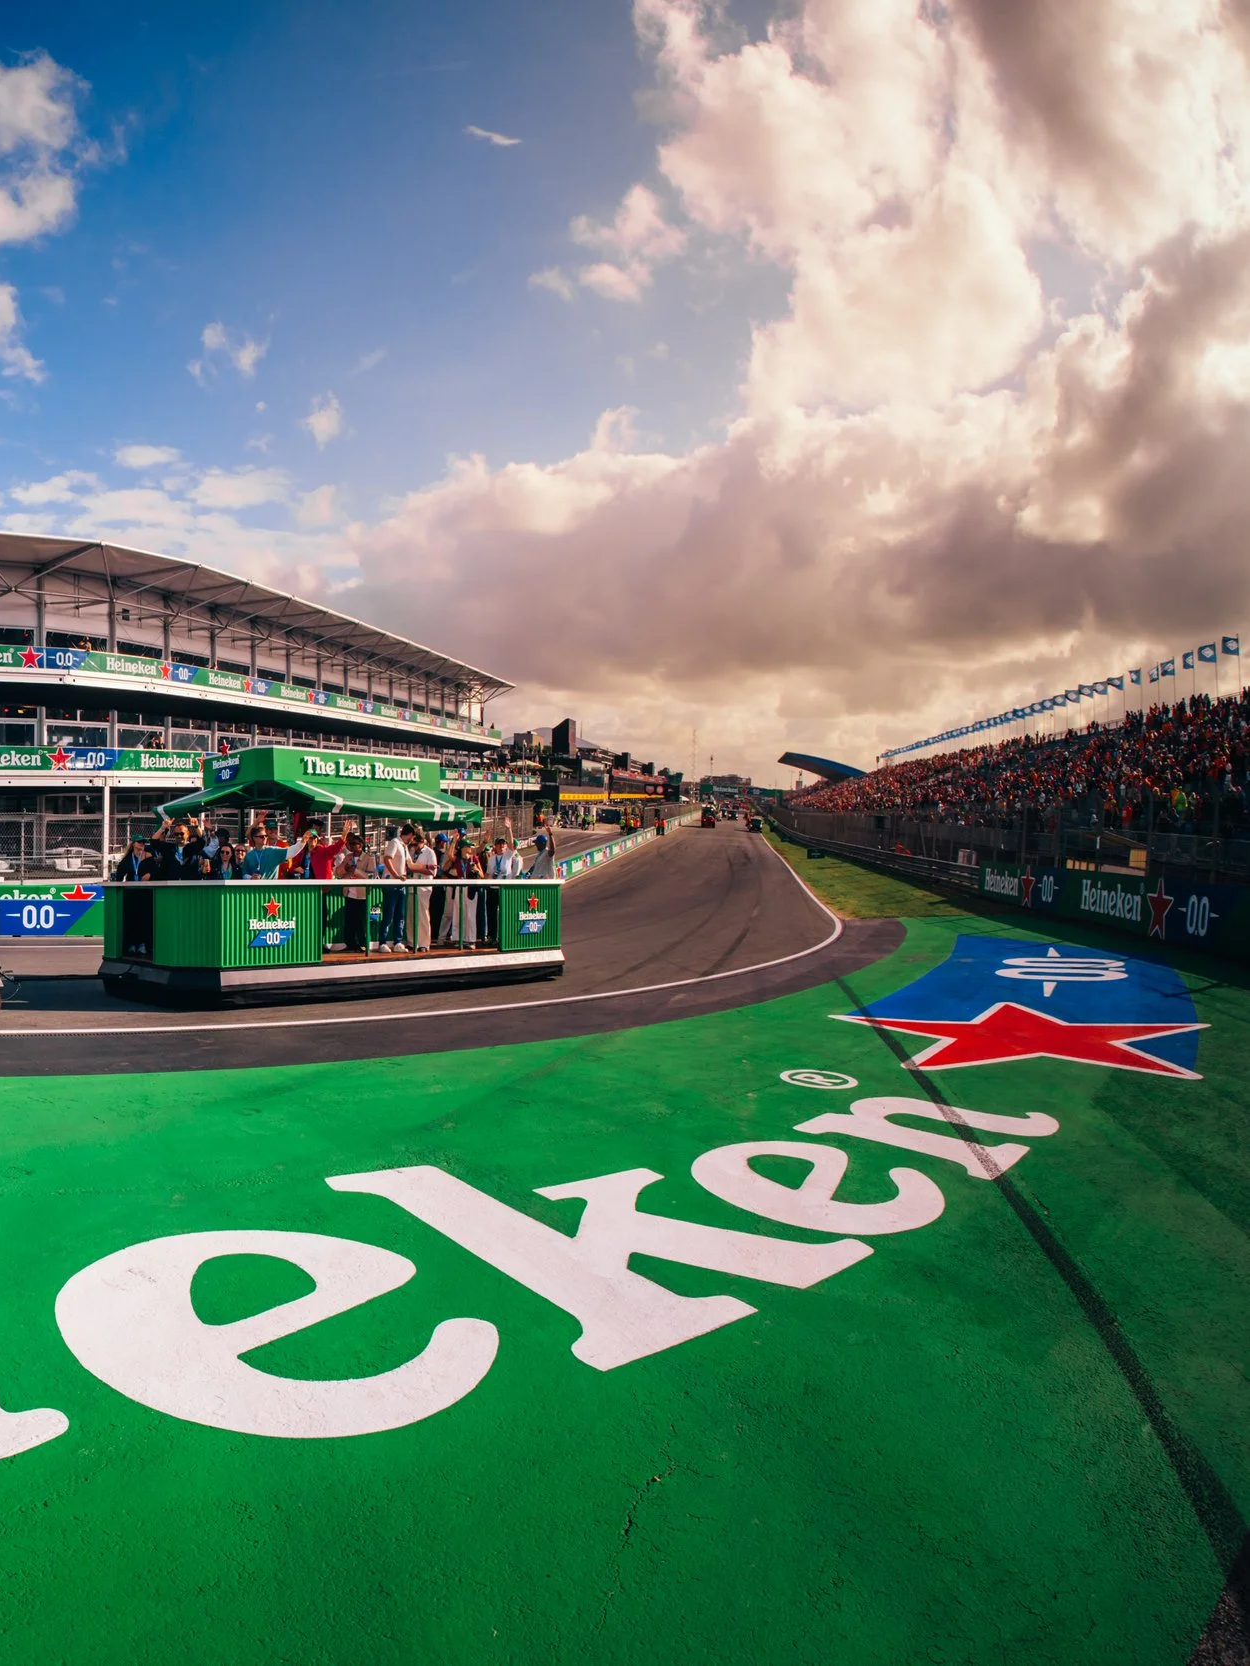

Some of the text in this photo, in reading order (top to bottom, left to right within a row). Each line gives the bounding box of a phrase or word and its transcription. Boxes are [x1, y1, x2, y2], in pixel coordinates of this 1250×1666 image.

[56, 652, 73, 666] 0.0
[106, 656, 157, 676] Heineken
[208, 672, 242, 689] Heineken
[140, 753, 193, 769] Heineken
[303, 756, 421, 782] The Last Round
[985, 868, 1019, 897] Heineken
[1080, 879, 1143, 922] Heineken
[1186, 895, 1210, 937] 0.0
[22, 905, 55, 929] 0.0
[249, 919, 296, 930] Heineken
[266, 932, 281, 945] 0.0
